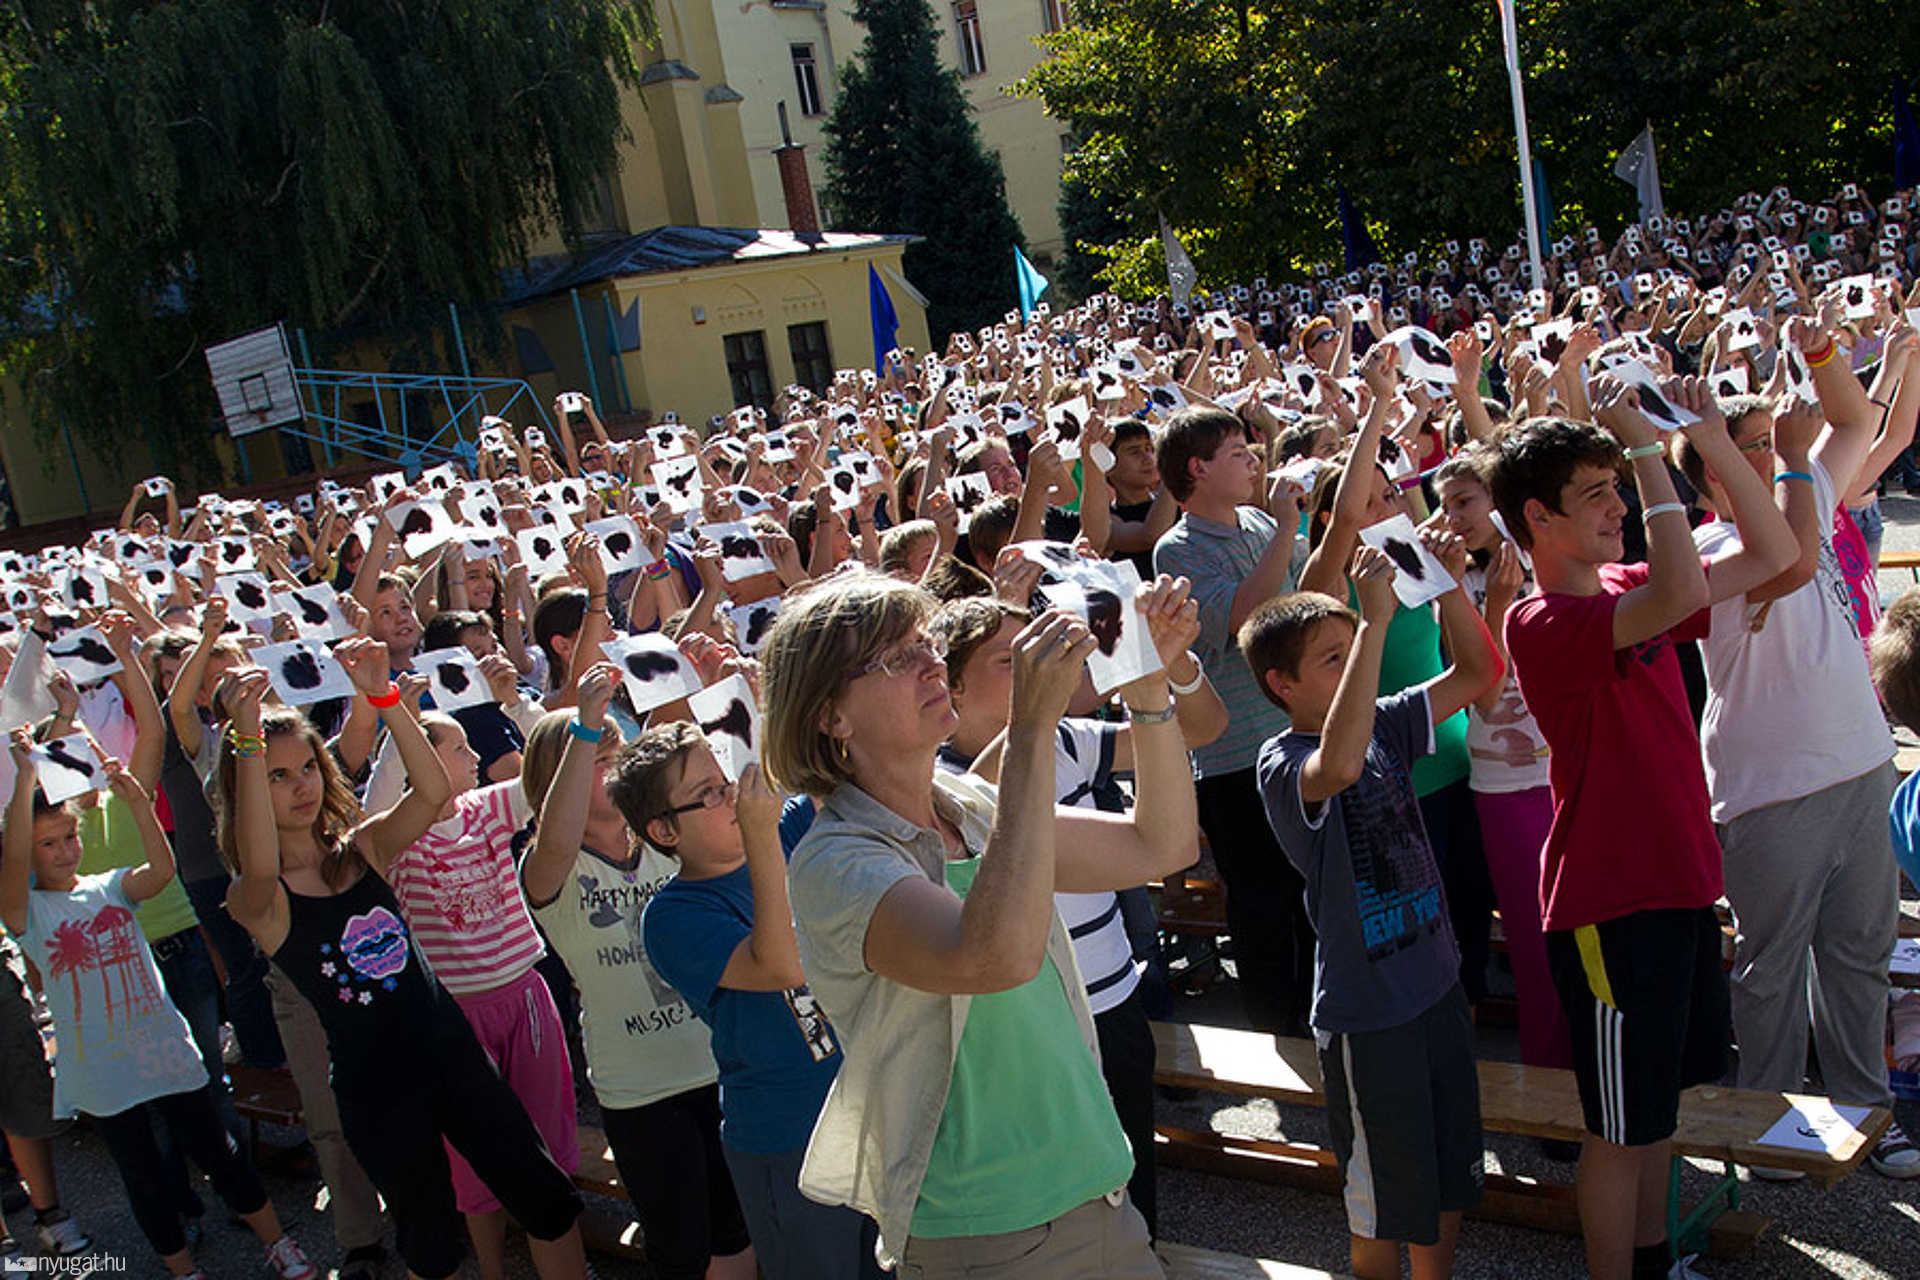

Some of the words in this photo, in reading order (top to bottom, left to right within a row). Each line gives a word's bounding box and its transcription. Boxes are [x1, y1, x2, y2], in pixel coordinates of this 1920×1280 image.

[580, 887, 628, 911] HAPPY
[632, 874, 672, 905] MAG
[624, 1000, 684, 1036] MUSIC
